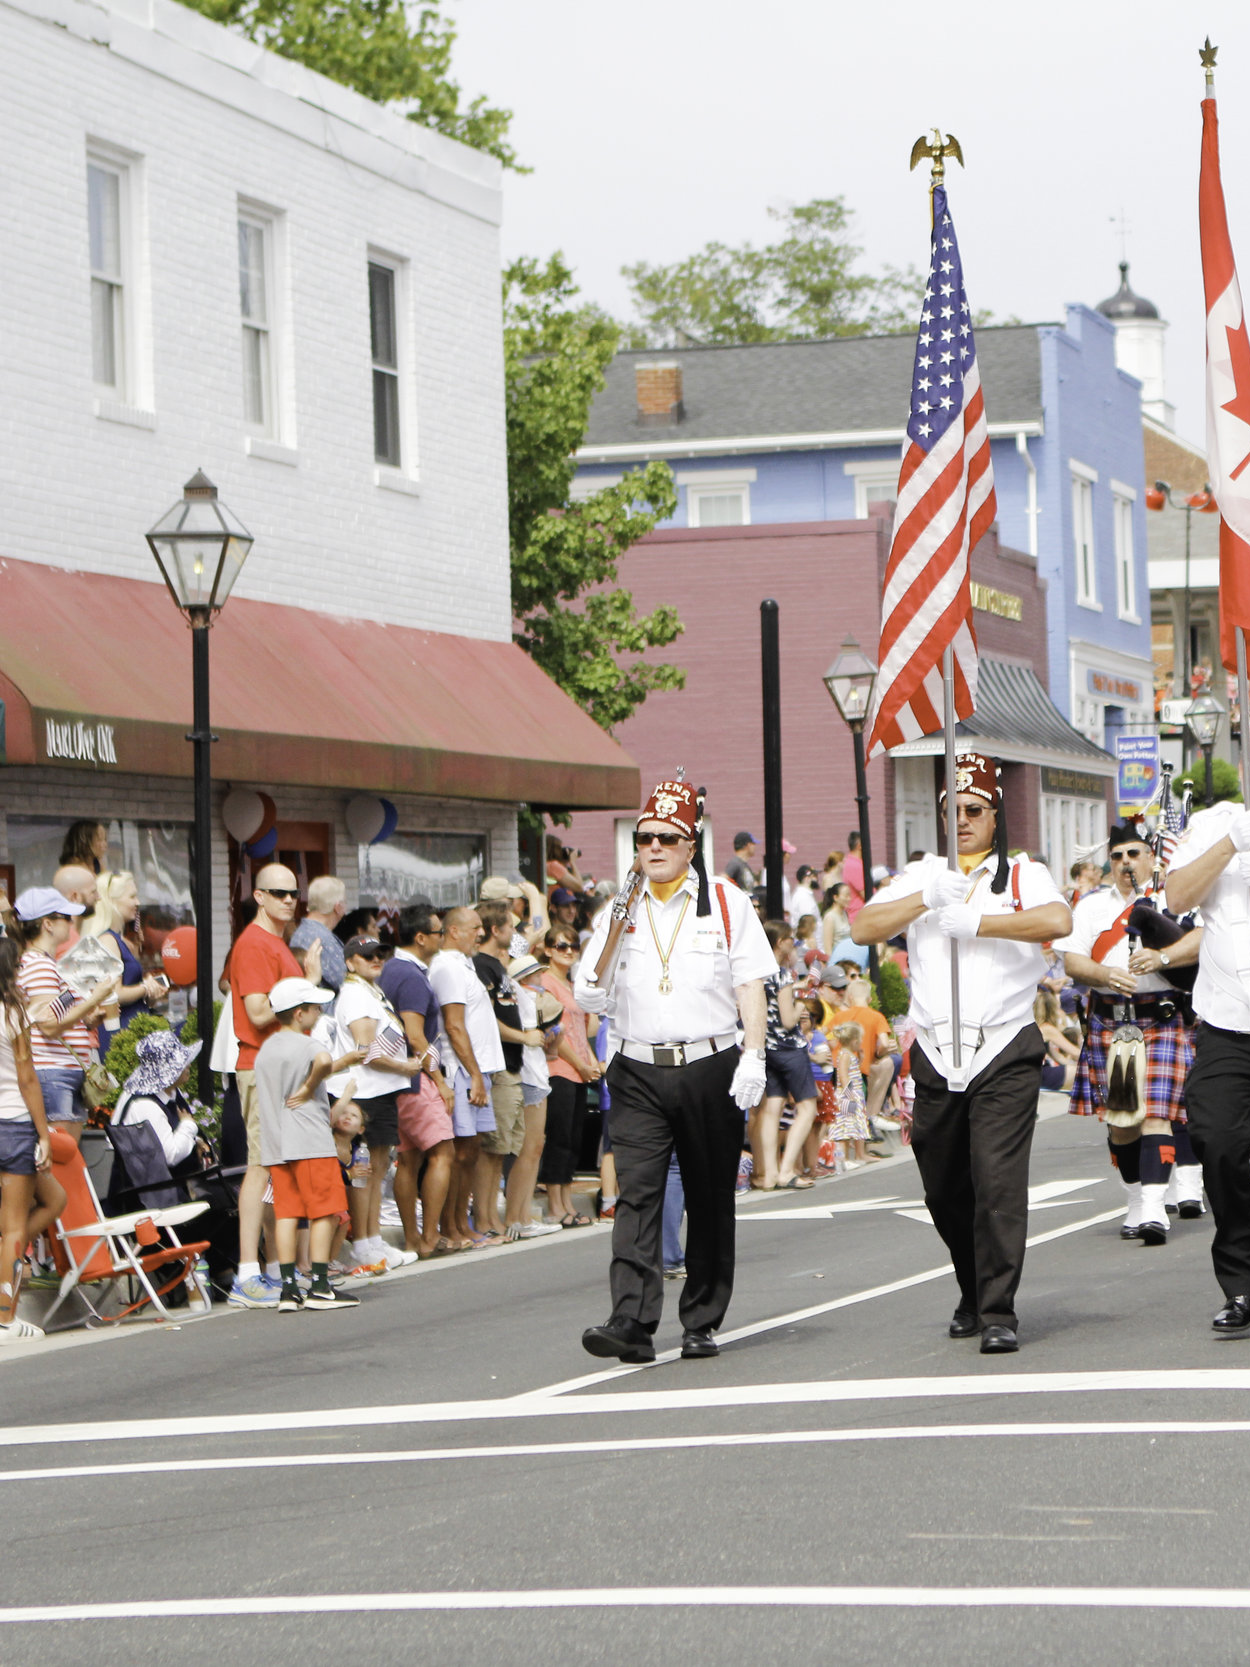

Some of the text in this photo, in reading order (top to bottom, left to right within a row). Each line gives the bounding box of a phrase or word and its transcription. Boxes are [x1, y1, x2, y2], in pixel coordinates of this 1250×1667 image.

[1119, 741, 1154, 752] Paint Your
[956, 754, 987, 773] ENA
[1133, 751, 1158, 760] Pottery
[652, 782, 690, 805] KENA
[969, 786, 993, 800] HONOR
[670, 816, 692, 835] HONOR
